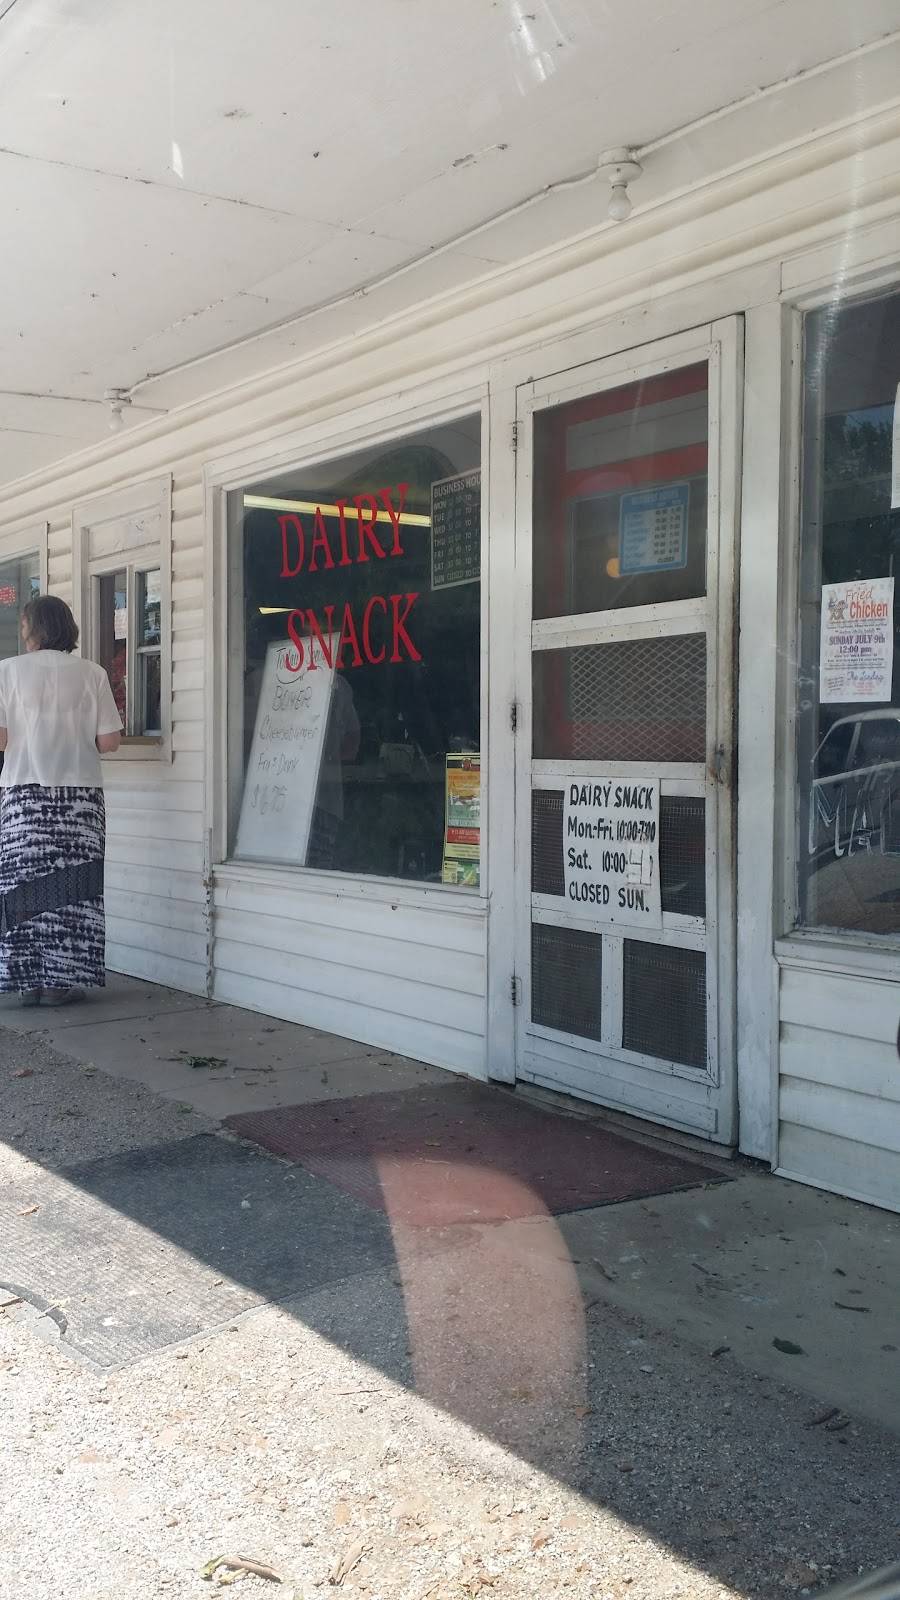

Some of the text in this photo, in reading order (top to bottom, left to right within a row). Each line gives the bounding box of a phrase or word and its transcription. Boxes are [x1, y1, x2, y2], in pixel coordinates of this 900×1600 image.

[434, 480, 464, 498] BUSINESS
[276, 483, 410, 578] DAIRY
[846, 587, 872, 601] Fried
[850, 600, 888, 619] Chicken
[285, 592, 423, 672] SNACK
[829, 633, 885, 646] SUNDAY JULY 9th
[839, 645, 872, 655] 12:00 pm
[570, 784, 654, 810] DAIRY SNACK
[568, 847, 592, 870] Sat.
[569, 881, 650, 912] CLOSED SUN.
